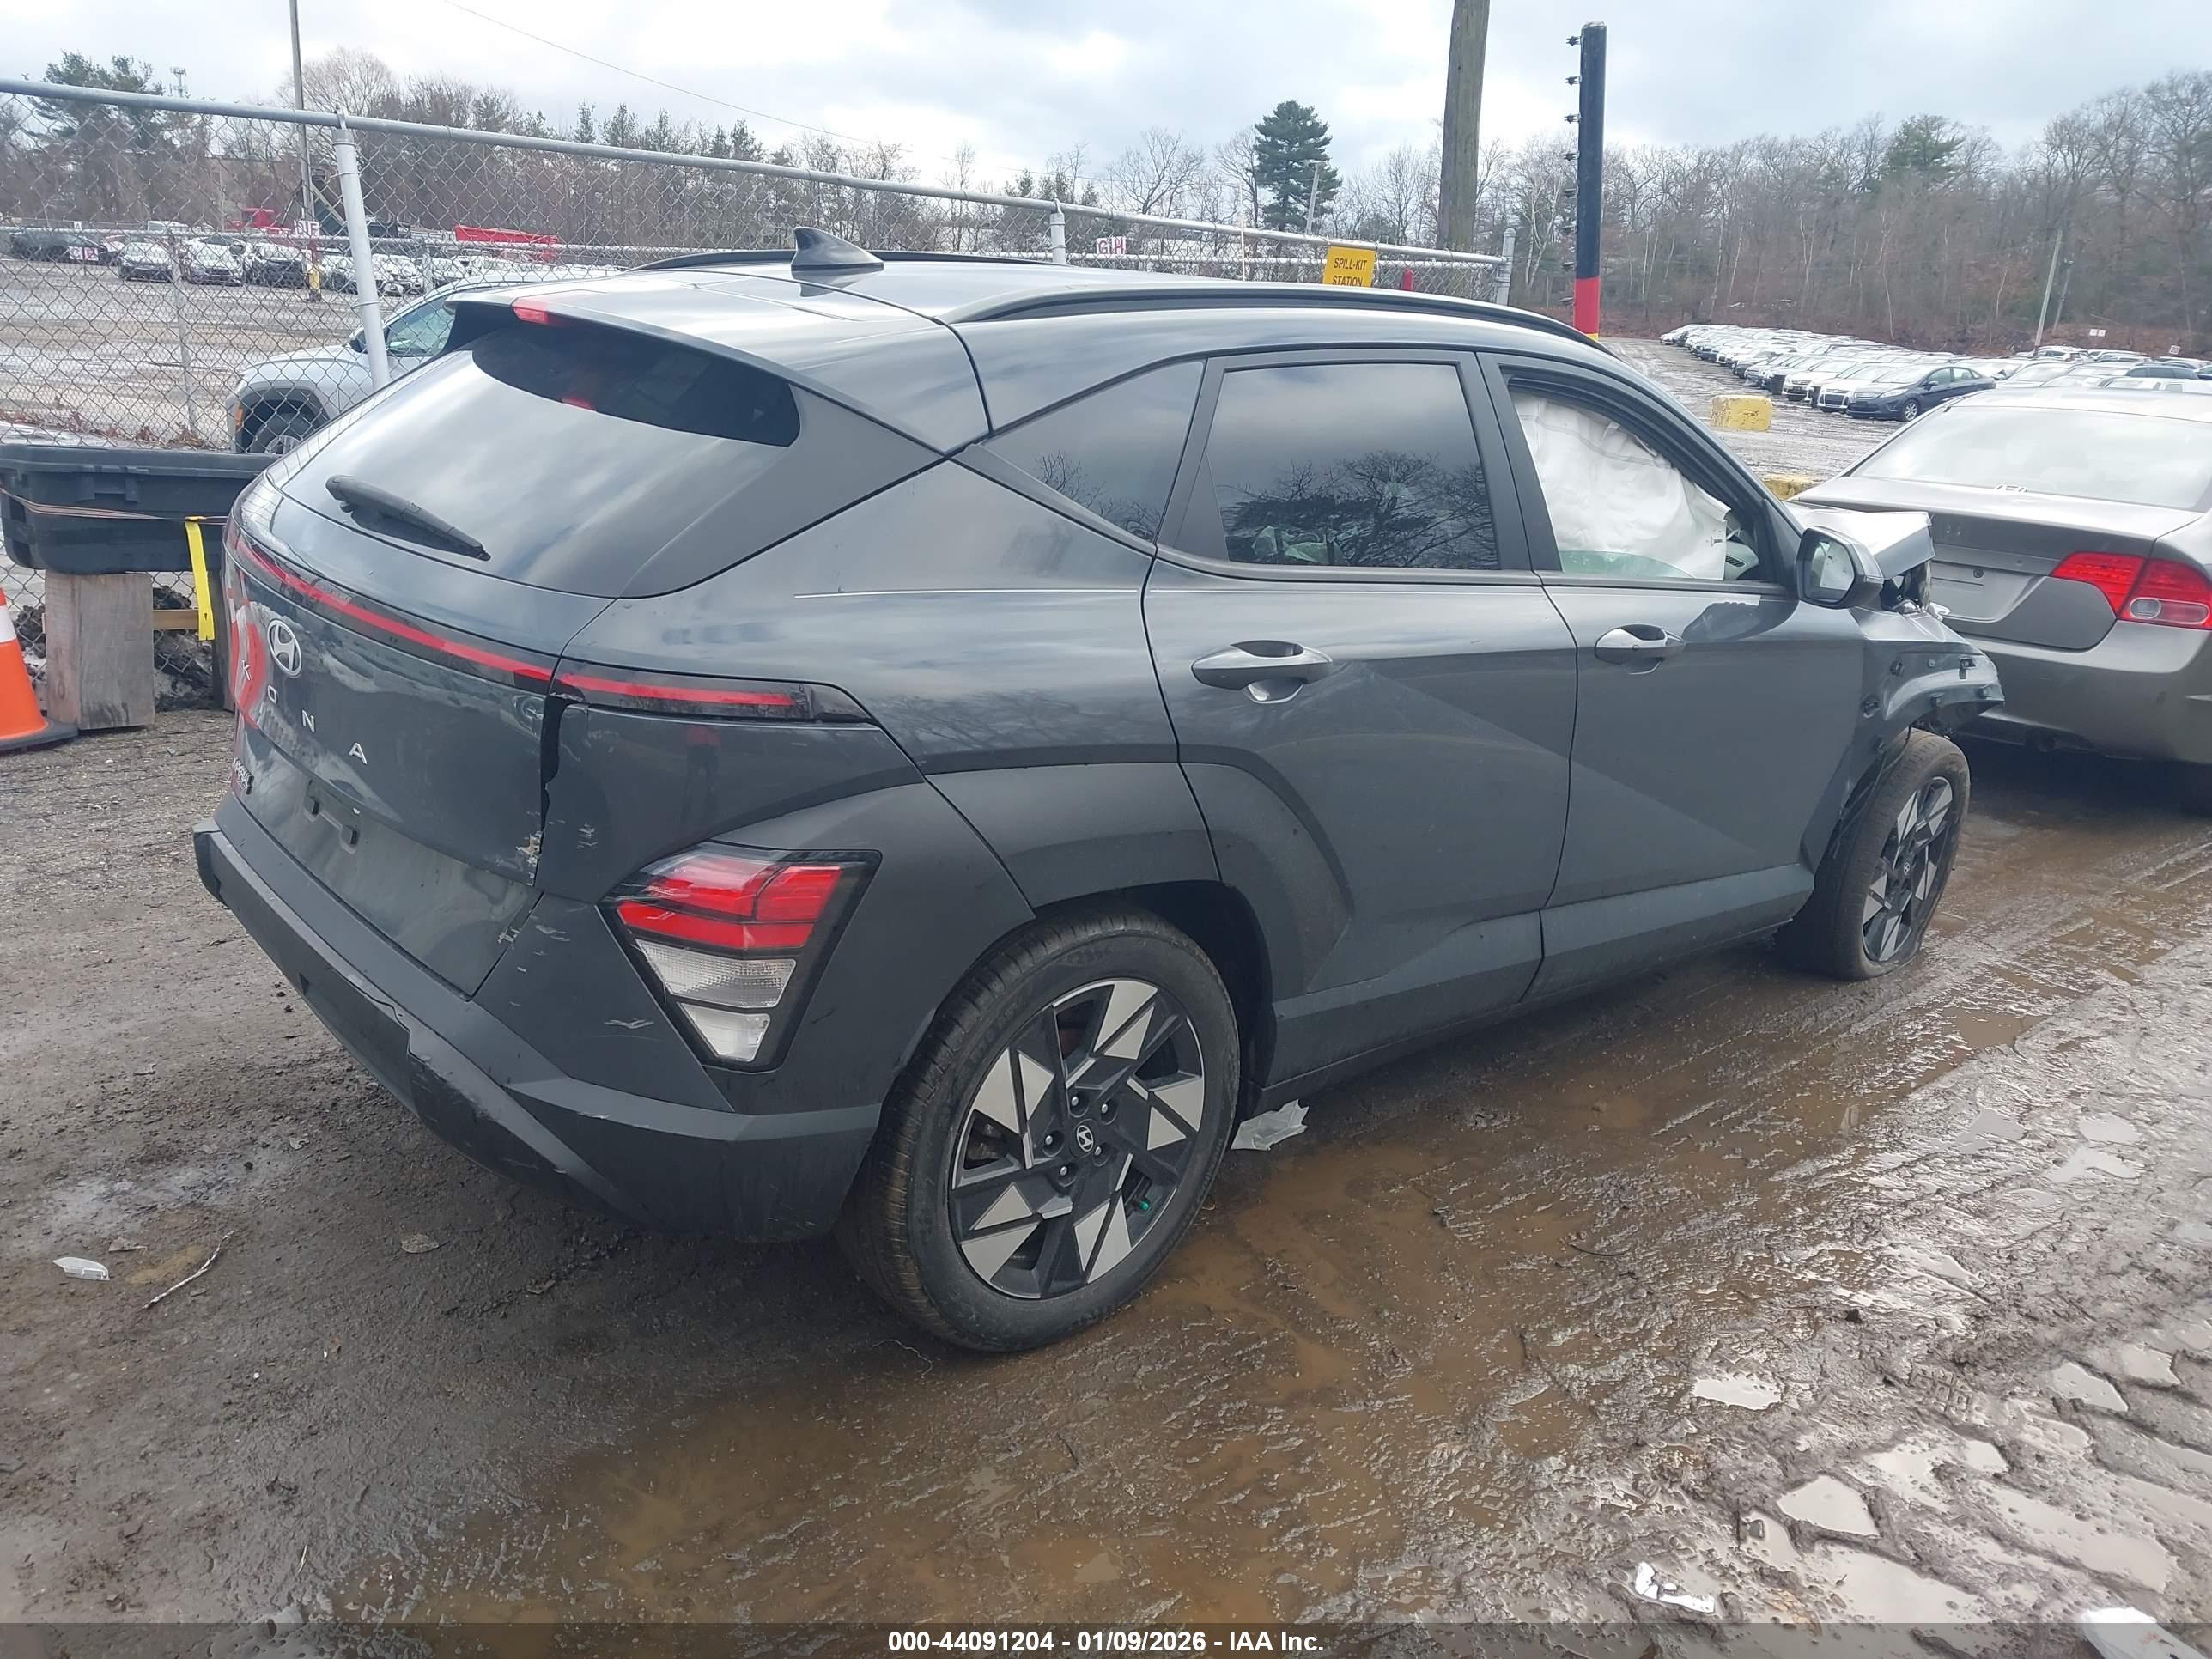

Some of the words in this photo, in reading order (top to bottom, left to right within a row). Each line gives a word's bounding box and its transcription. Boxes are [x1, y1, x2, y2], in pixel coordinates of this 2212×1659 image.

[1334, 258, 1367, 270] SPILL-KIT
[1332, 275, 1363, 287] STATION
[241, 659, 368, 765] KONA
